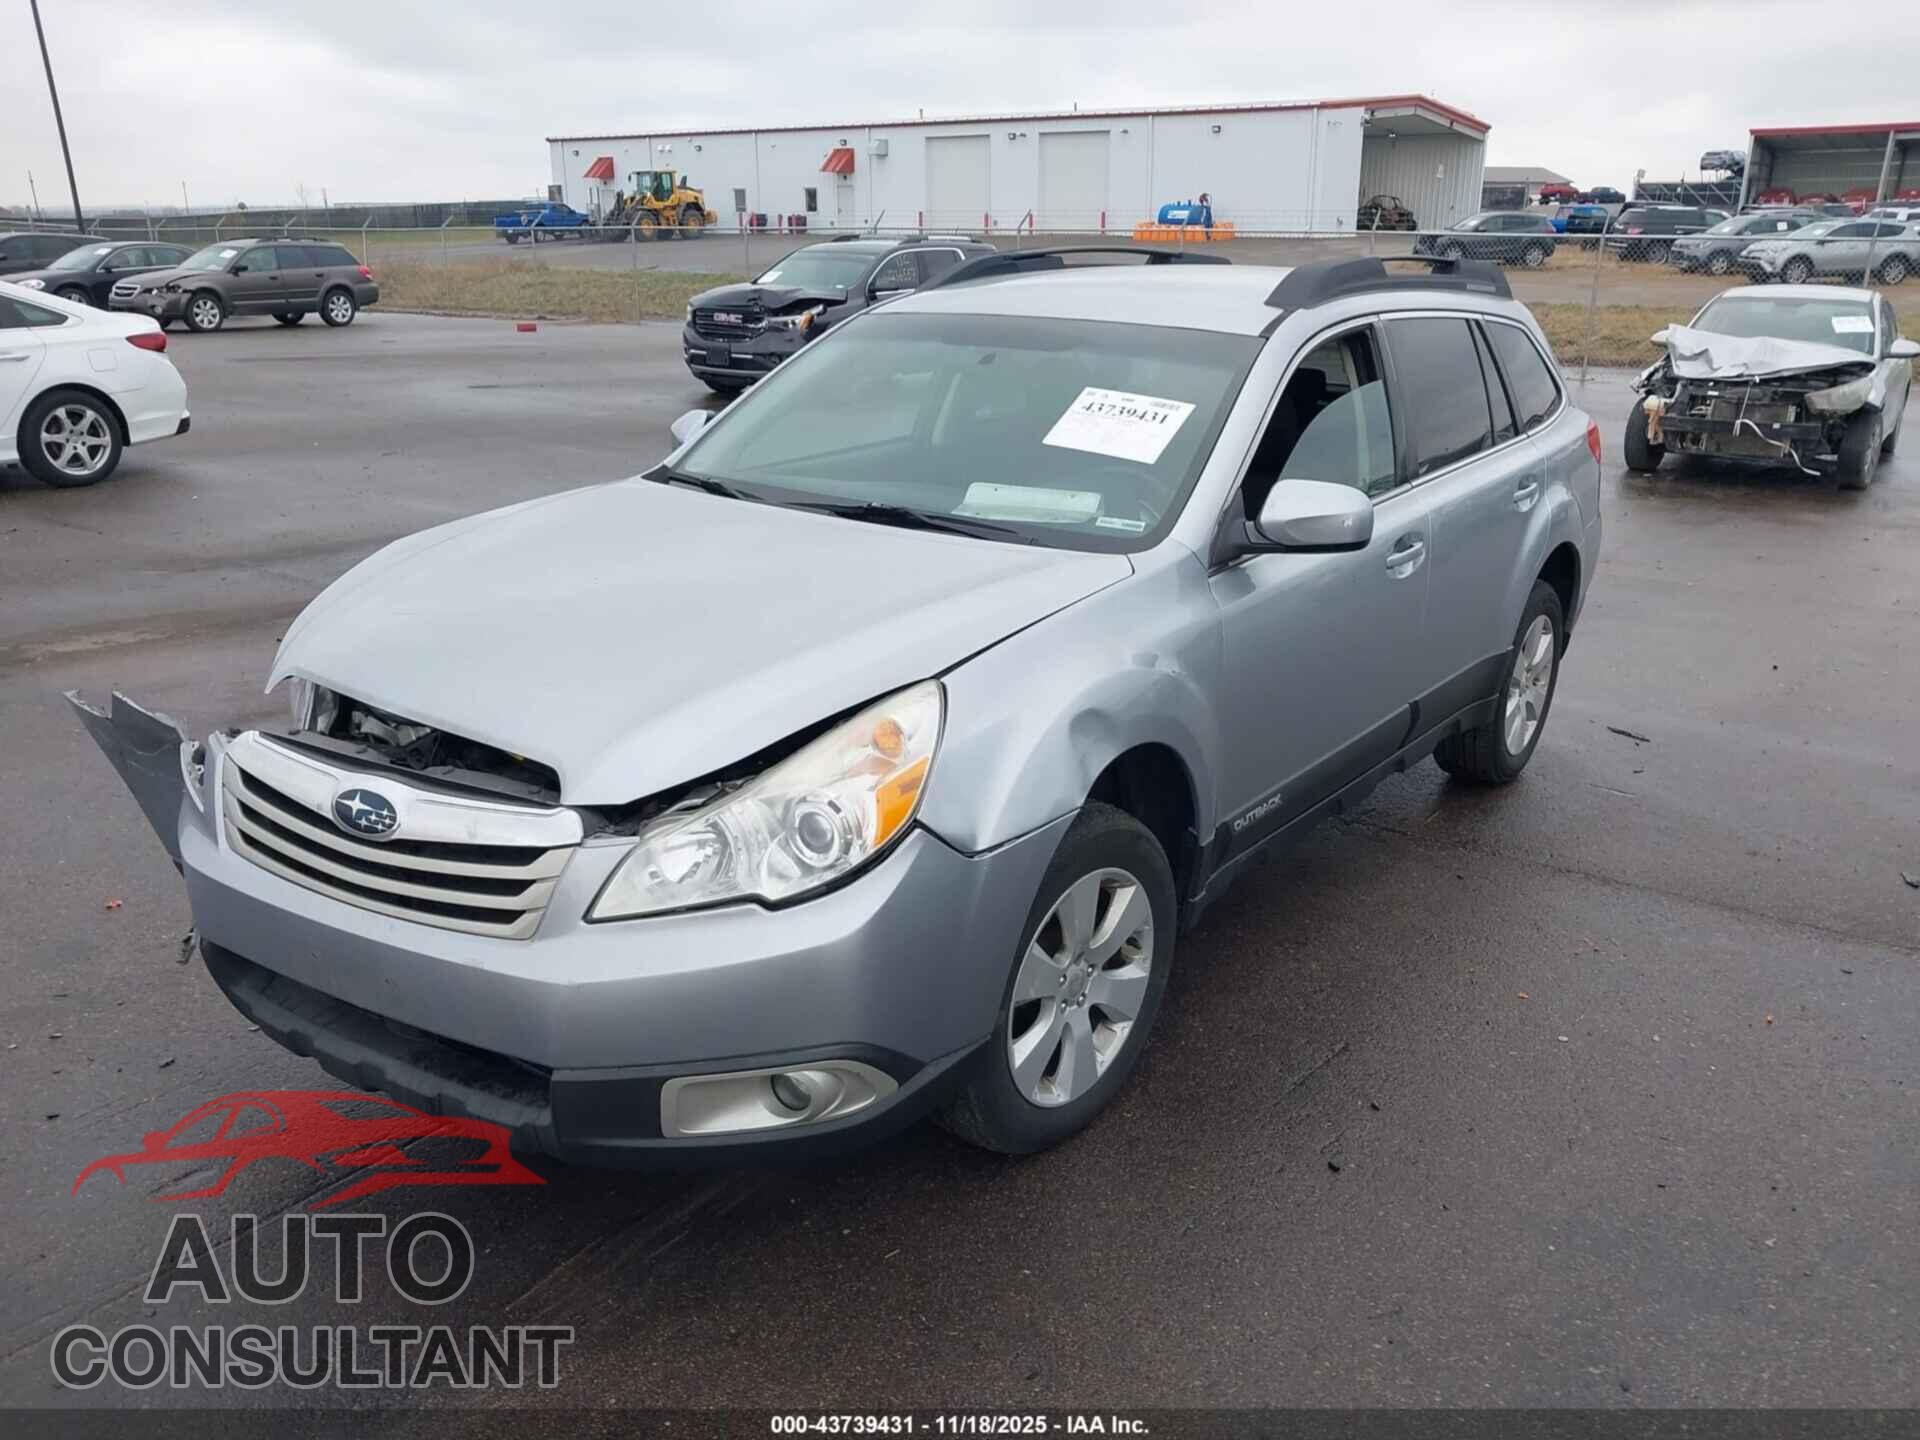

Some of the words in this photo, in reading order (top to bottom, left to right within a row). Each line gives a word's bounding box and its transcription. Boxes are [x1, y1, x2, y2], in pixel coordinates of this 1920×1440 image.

[713, 313, 743, 323] GMC
[1081, 401, 1169, 424] 43739431
[1233, 792, 1282, 831] OUTBACK
